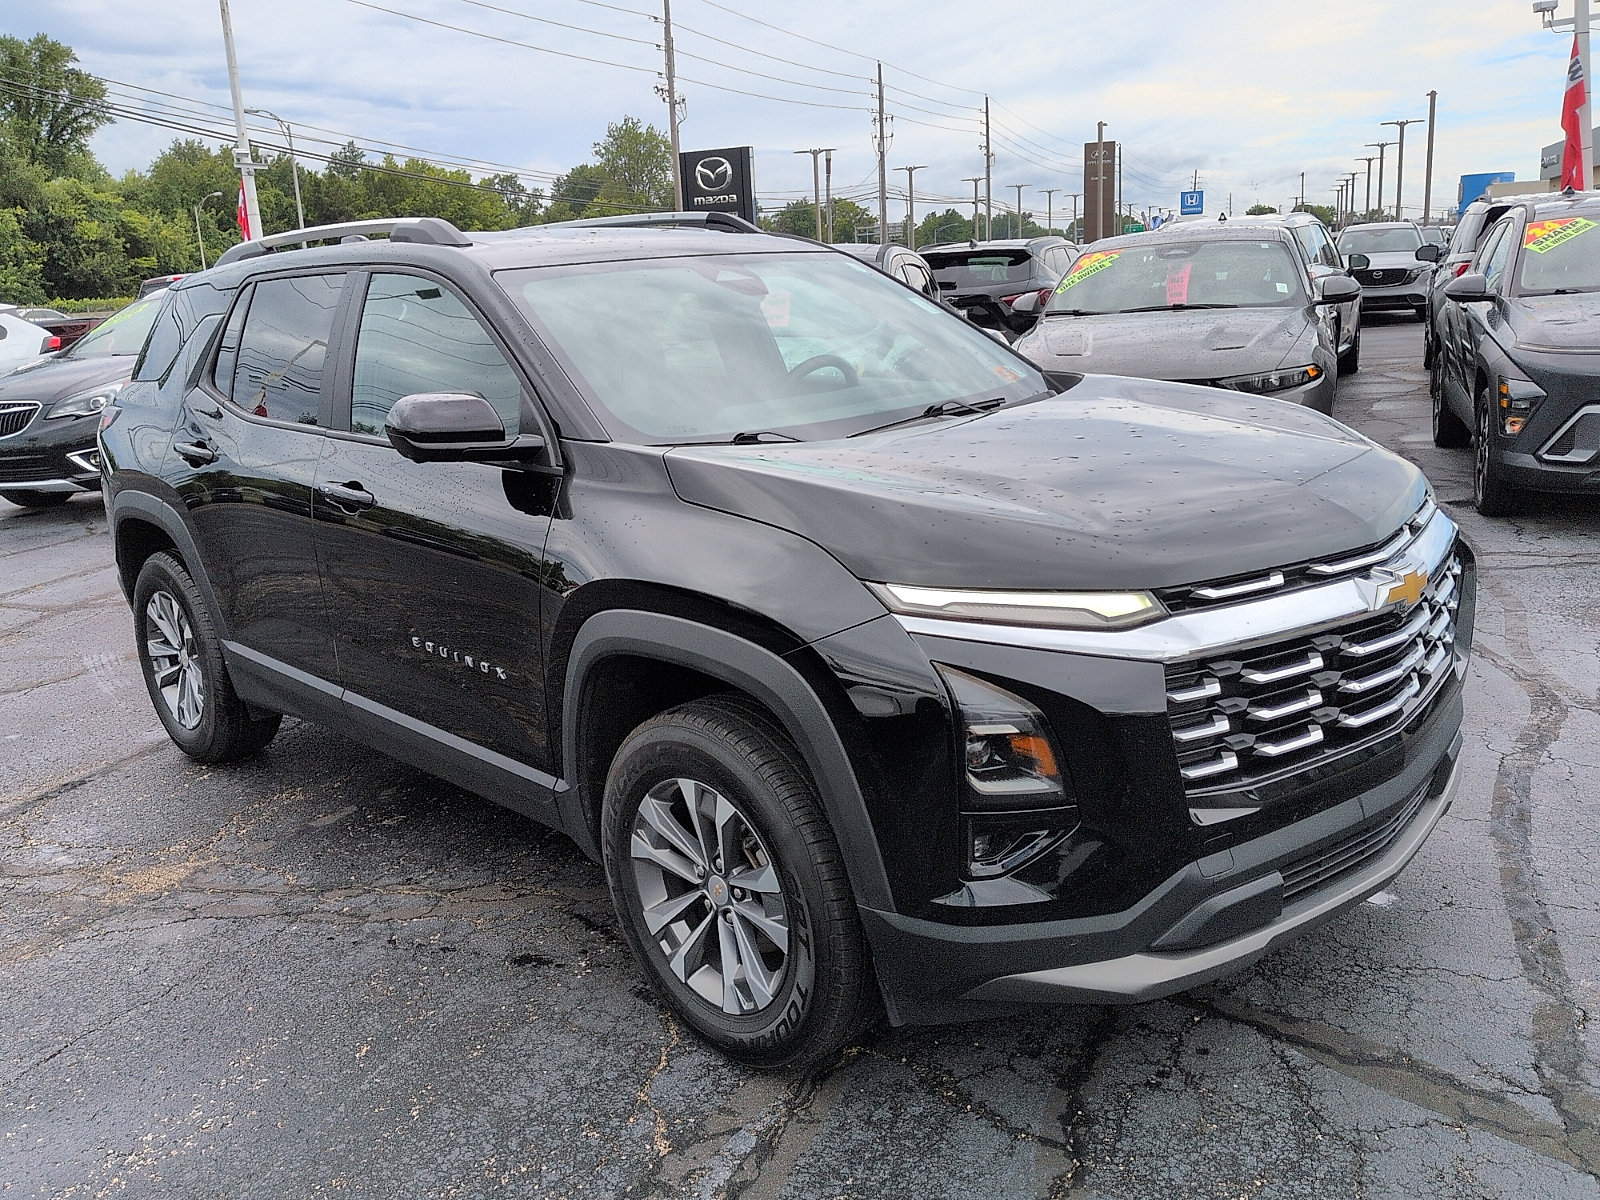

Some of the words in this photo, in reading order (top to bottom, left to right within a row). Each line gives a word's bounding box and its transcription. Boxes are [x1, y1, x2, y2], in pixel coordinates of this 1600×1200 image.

[1532, 220, 1579, 246] SHARP
[1538, 243, 1551, 252] ALL
[1551, 232, 1573, 245] WHEEL
[1571, 222, 1591, 234] DRIVE
[1060, 279, 1077, 291] ONE
[1077, 262, 1106, 280] OWNER
[1066, 274, 1077, 282] ALL
[1078, 262, 1097, 275] WHEEL
[411, 636, 508, 680] EQUINOX
